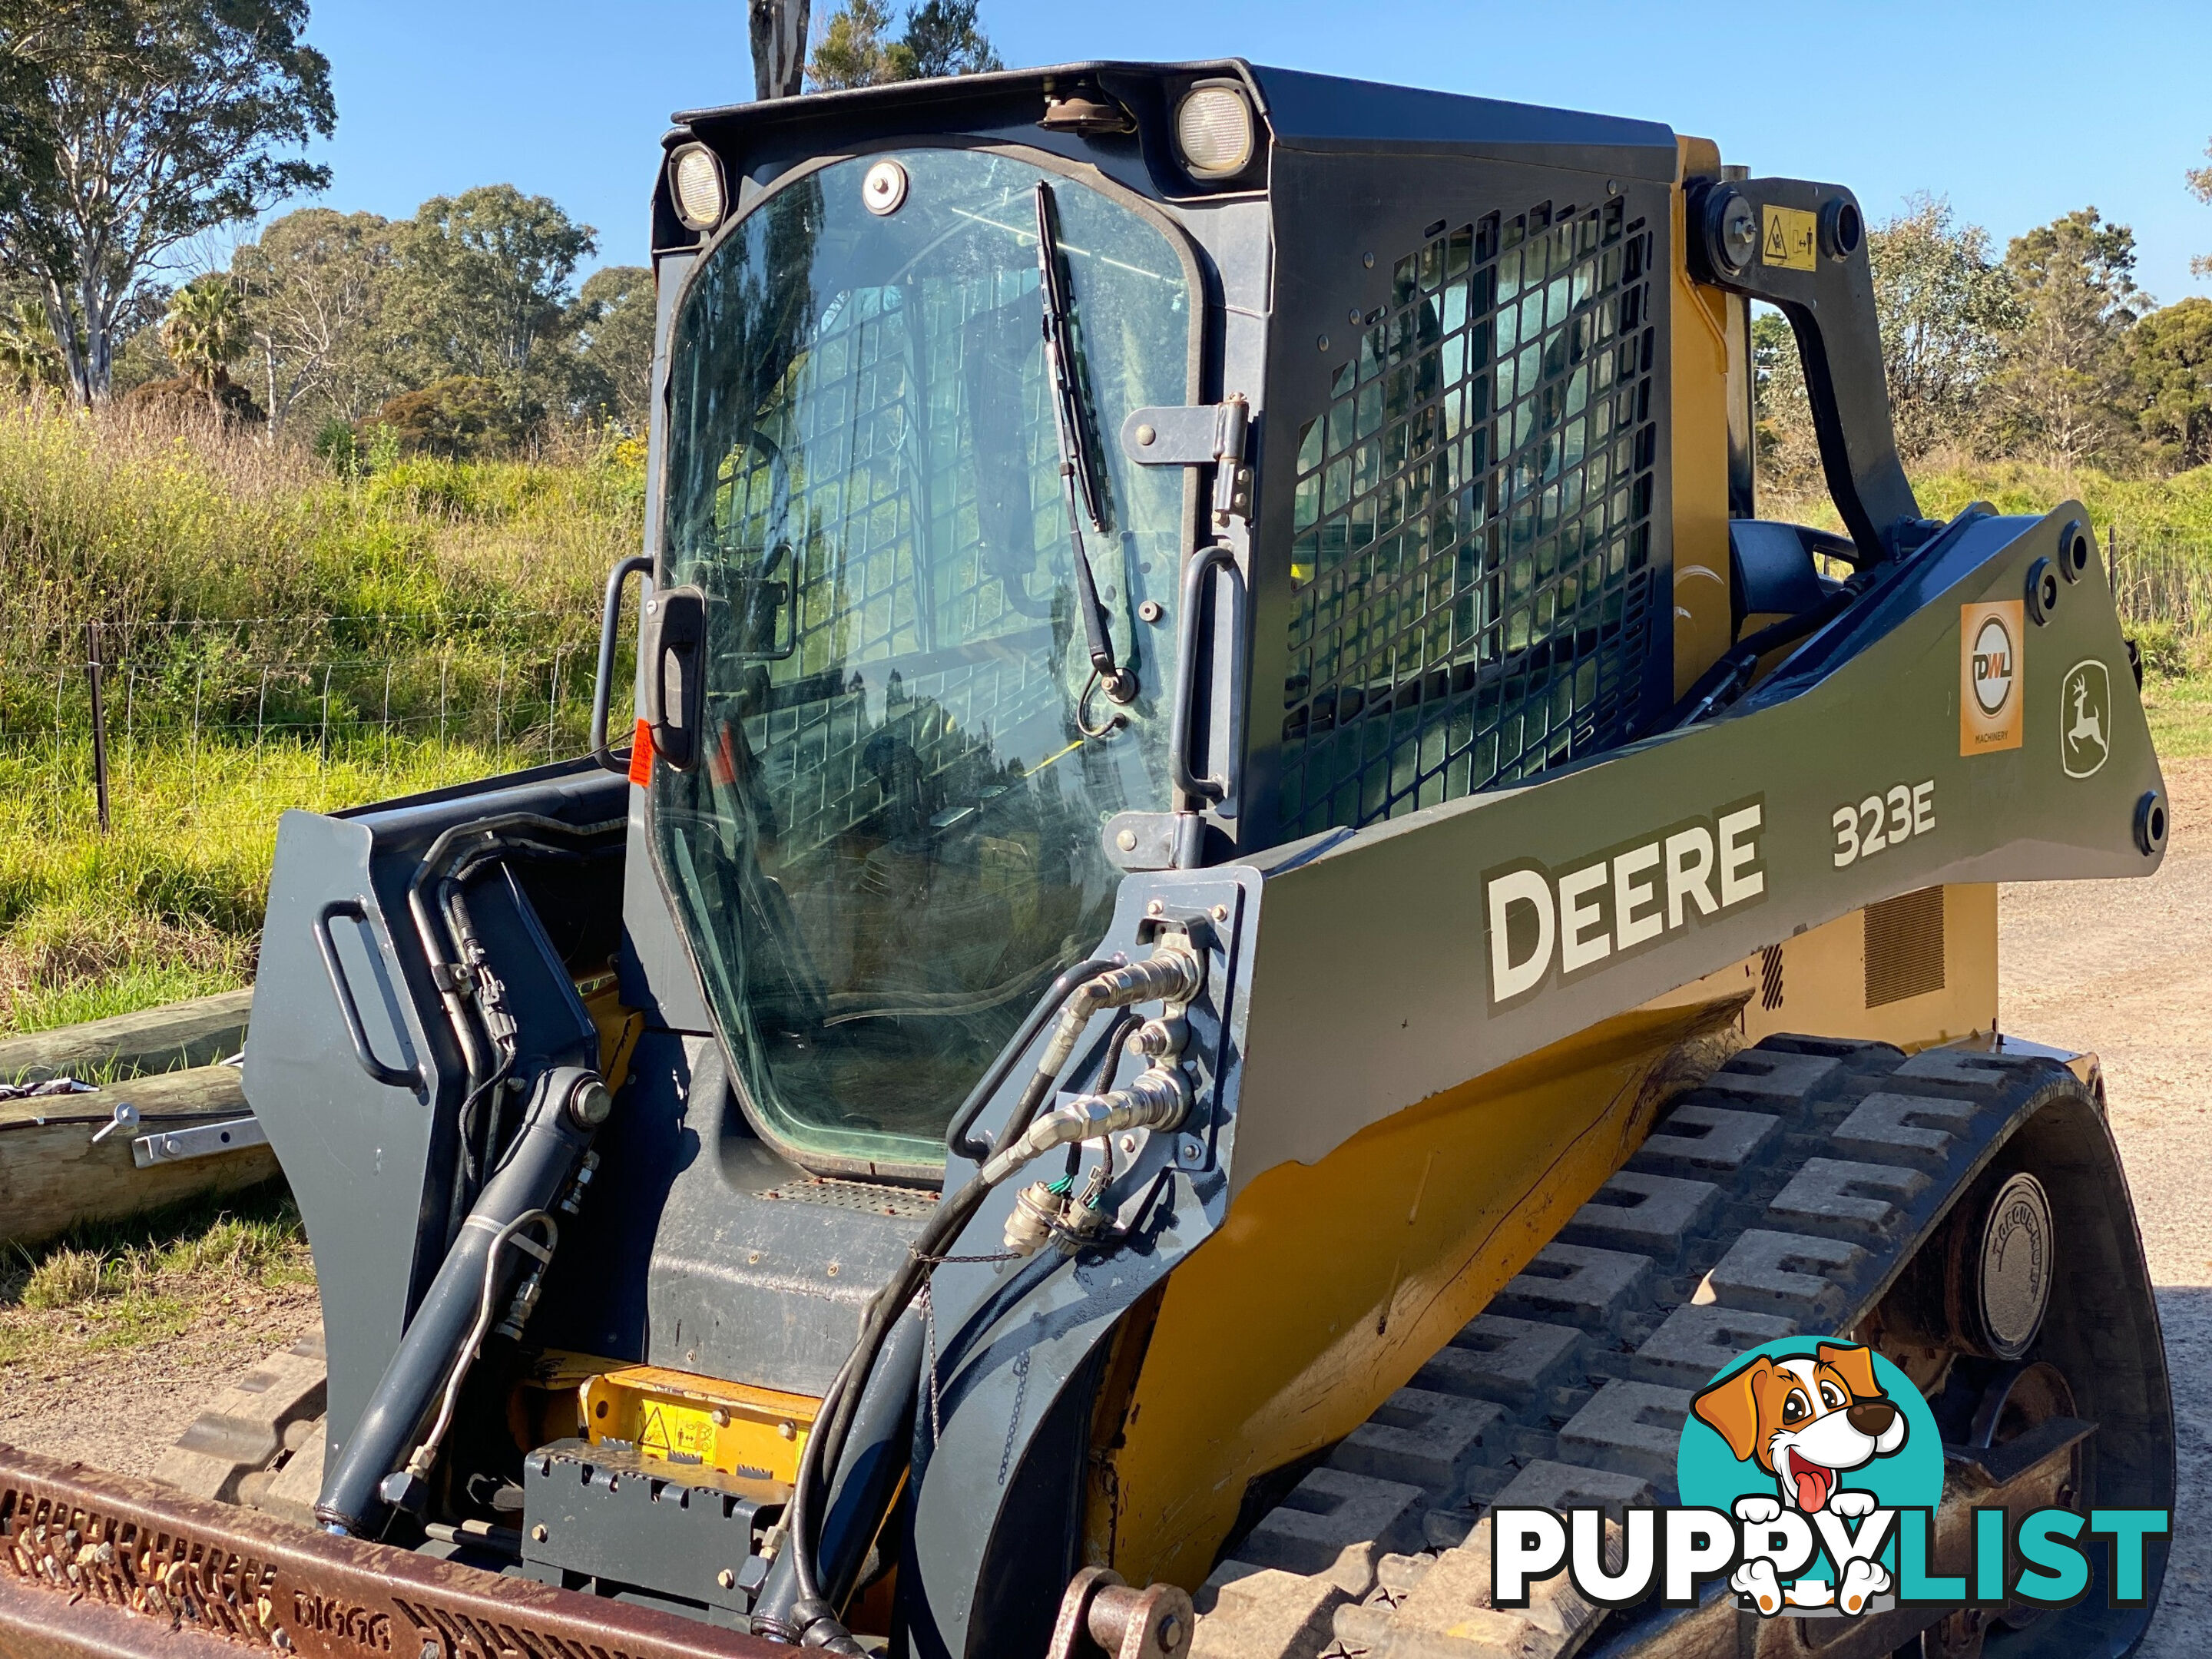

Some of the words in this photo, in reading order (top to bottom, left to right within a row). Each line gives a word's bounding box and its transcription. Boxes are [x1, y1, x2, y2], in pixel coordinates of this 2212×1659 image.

[1973, 652, 2012, 681] DWL
[1975, 730, 2009, 744] MACHINERY
[1830, 779, 1936, 868] 323E
[1487, 803, 1765, 1003] DEERE
